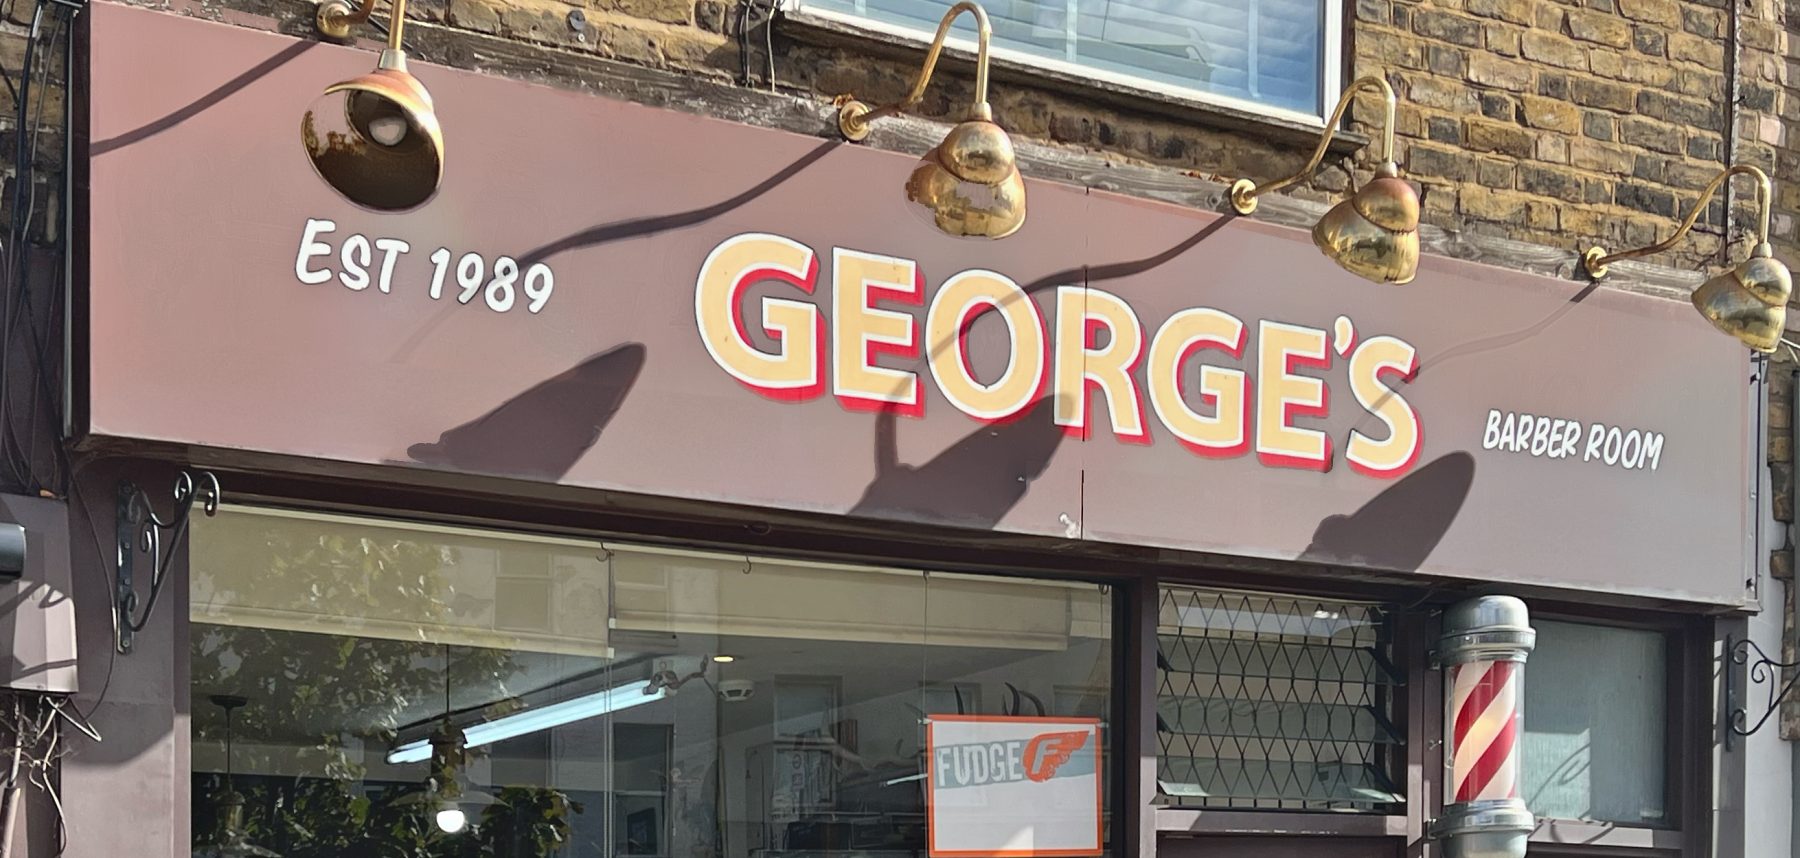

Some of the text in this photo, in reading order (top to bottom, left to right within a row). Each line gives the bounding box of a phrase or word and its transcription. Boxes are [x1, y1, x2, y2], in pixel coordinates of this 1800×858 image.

[295, 218, 555, 315] EST 1989
[694, 232, 1424, 478] GEORGE'S
[1483, 409, 1665, 471] BARBER ROOM
[937, 741, 1022, 787] FUDGE
